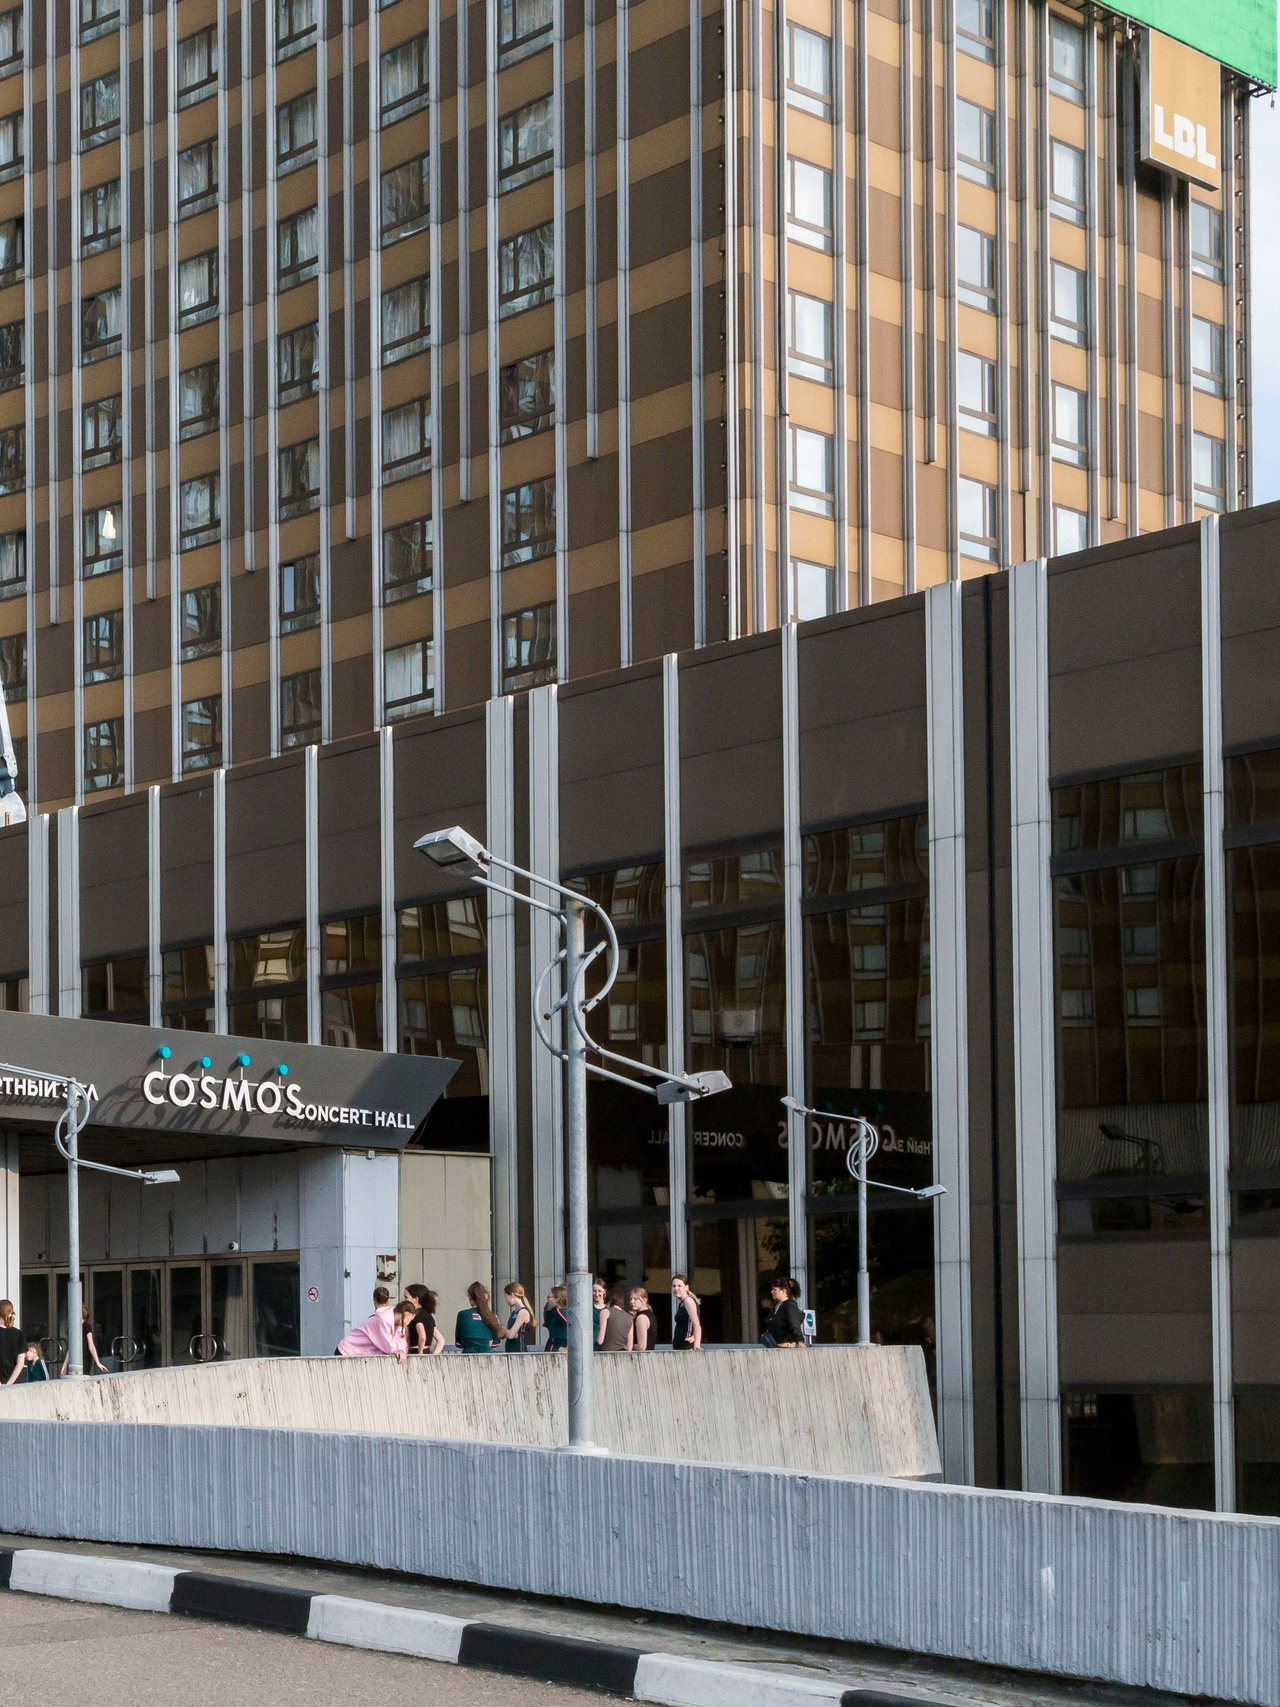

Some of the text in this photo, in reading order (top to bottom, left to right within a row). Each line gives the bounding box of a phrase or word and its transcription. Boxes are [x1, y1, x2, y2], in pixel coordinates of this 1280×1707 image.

[1154, 103, 1216, 169] LBL
[143, 1071, 301, 1116] COSMOS
[296, 1103, 416, 1129] CONCERT HALL
